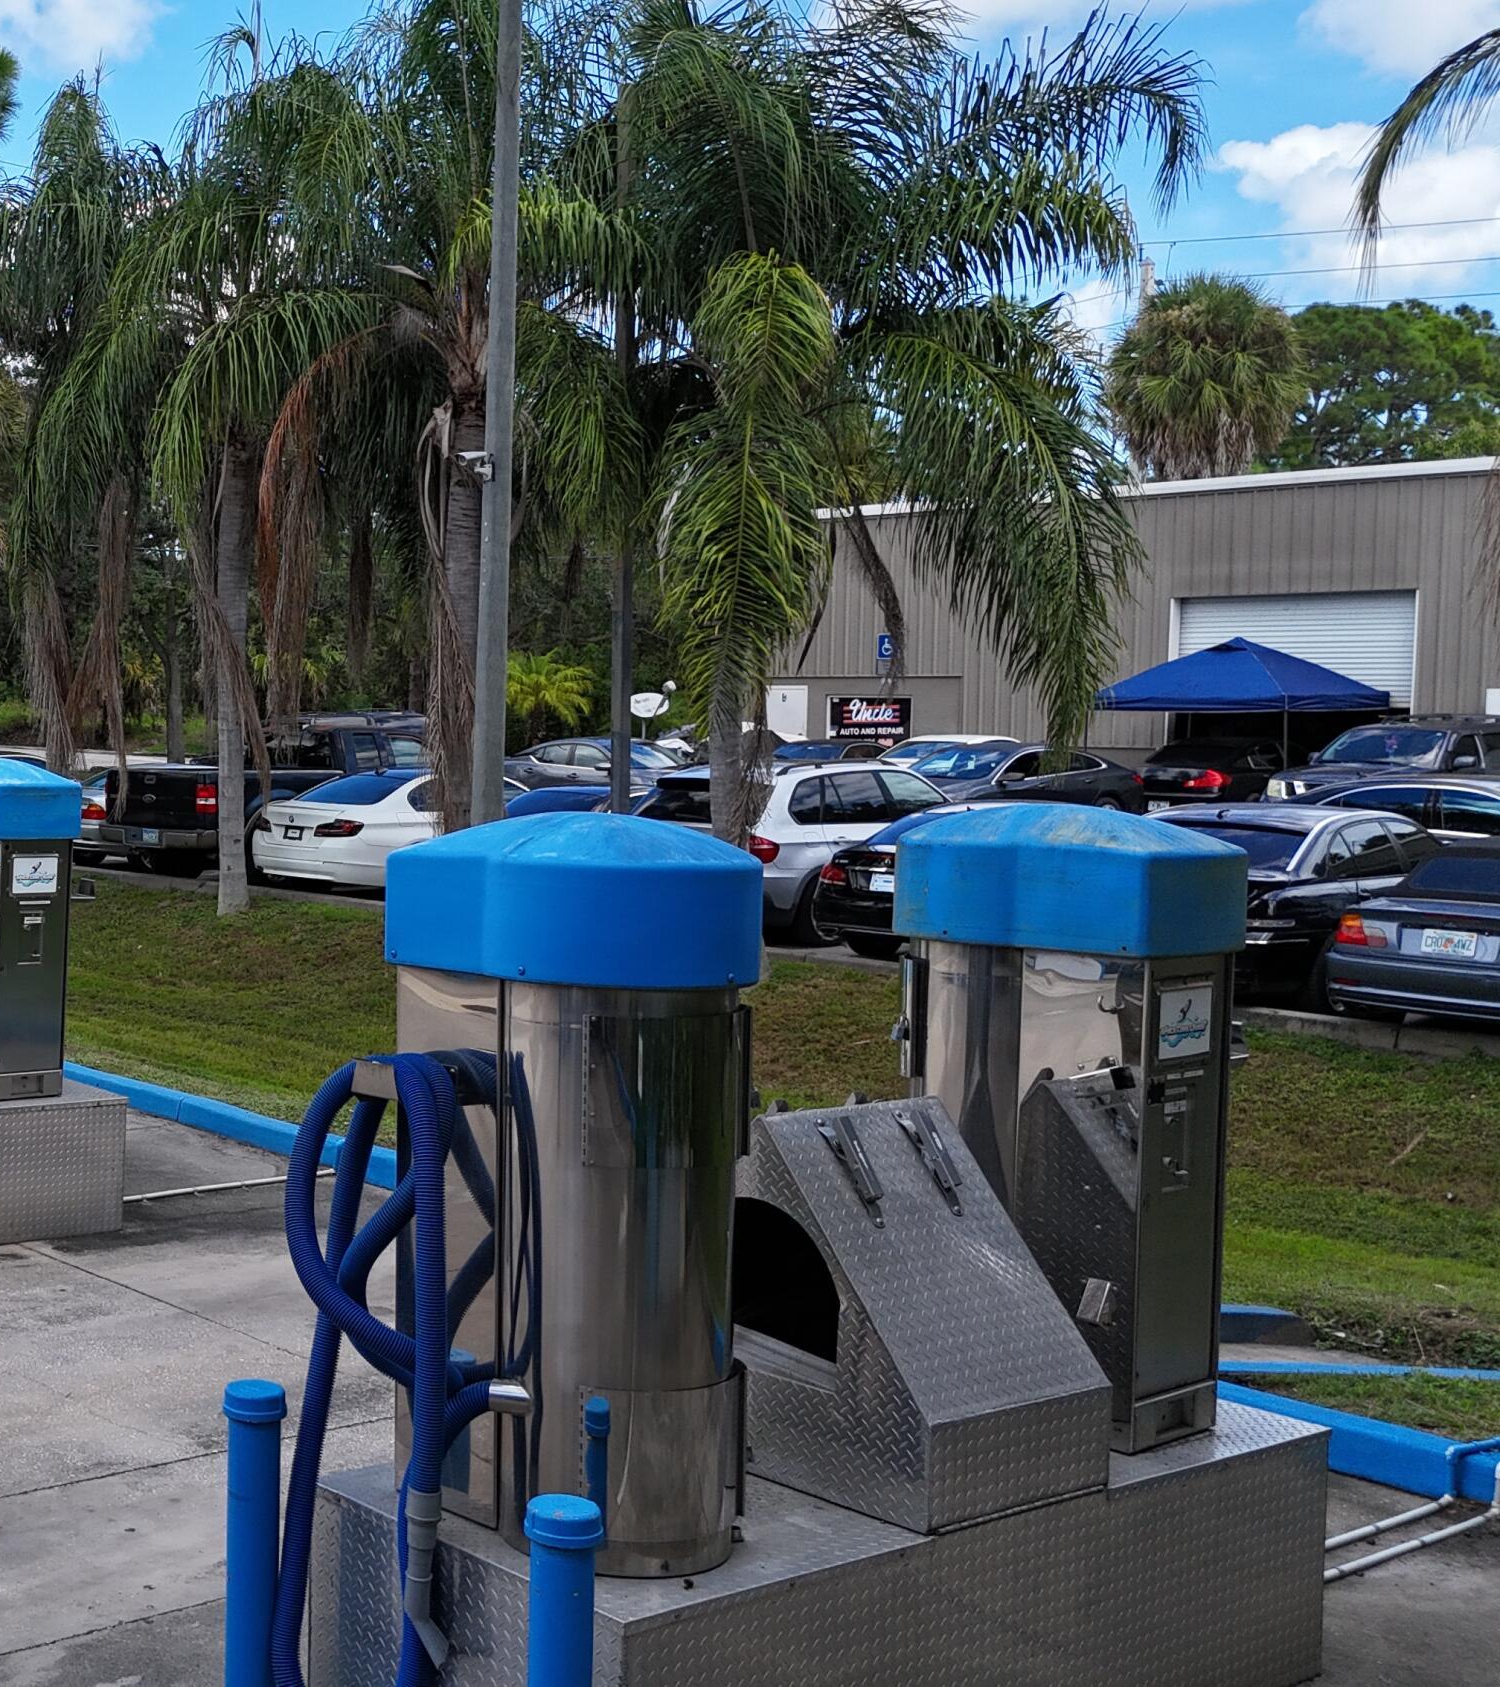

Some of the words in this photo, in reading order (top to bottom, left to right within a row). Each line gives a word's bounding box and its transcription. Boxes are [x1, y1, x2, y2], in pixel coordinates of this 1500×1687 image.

[849, 699, 894, 722] Uncle
[840, 727, 860, 736] AUTO
[861, 727, 876, 735] AND
[877, 726, 904, 735] REPAIR
